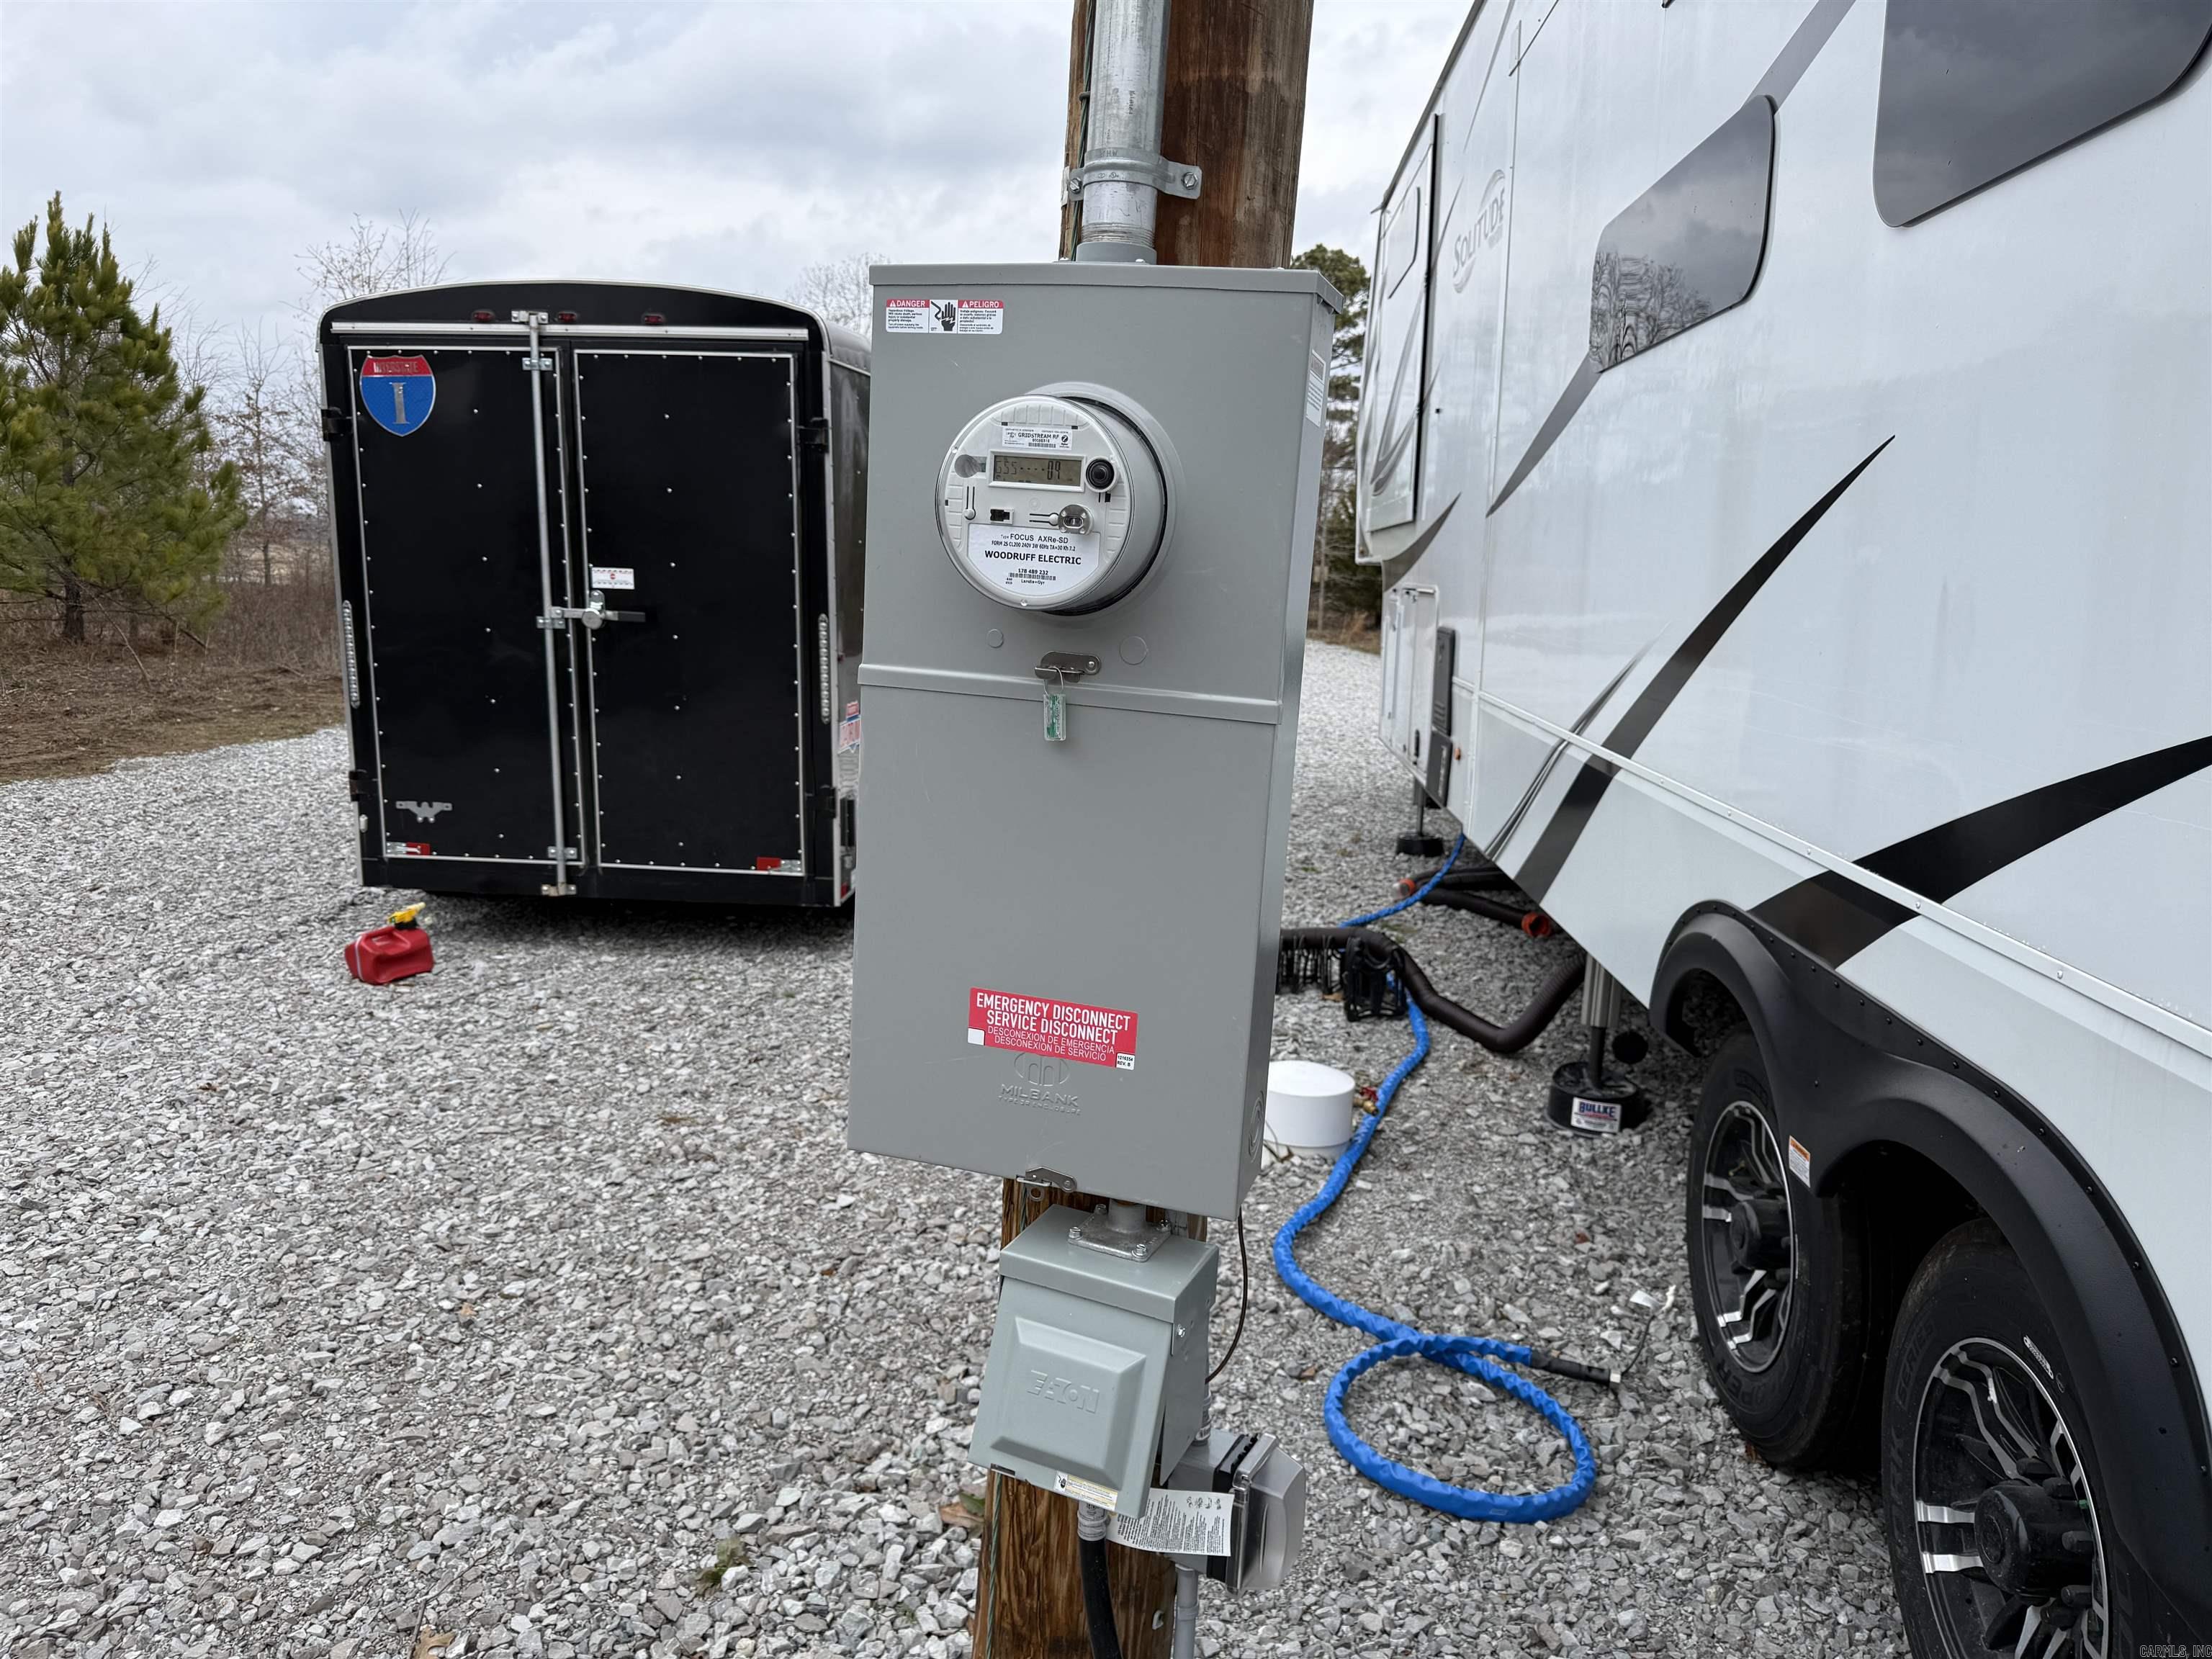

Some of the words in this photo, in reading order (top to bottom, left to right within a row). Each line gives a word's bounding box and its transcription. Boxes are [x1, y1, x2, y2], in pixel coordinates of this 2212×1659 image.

[1453, 186, 1505, 279] SOLITUDE
[1010, 533, 1034, 541] FOCUS
[1038, 535, 1069, 544] AXRe-SD
[984, 550, 1036, 561] WOODRUFF
[1038, 554, 1082, 565] ELECTRIC
[976, 992, 1050, 1018] EMERGENCY
[1053, 1004, 1131, 1031] DISCONNECT
[986, 1010, 1037, 1032] SERVICE
[1040, 1018, 1118, 1045] DISCONNECT
[988, 1025, 1046, 1043] DESCONEXION
[1048, 1035, 1058, 1045] DE
[1061, 1038, 1115, 1054] EMERGENCIA
[994, 1035, 1052, 1052] DESCONEXION
[1054, 1045, 1066, 1054] DE
[1068, 1048, 1107, 1061] SERVICIO
[1001, 1083, 1079, 1107] MILBANK
[1026, 1369, 1100, 1414] EATON
